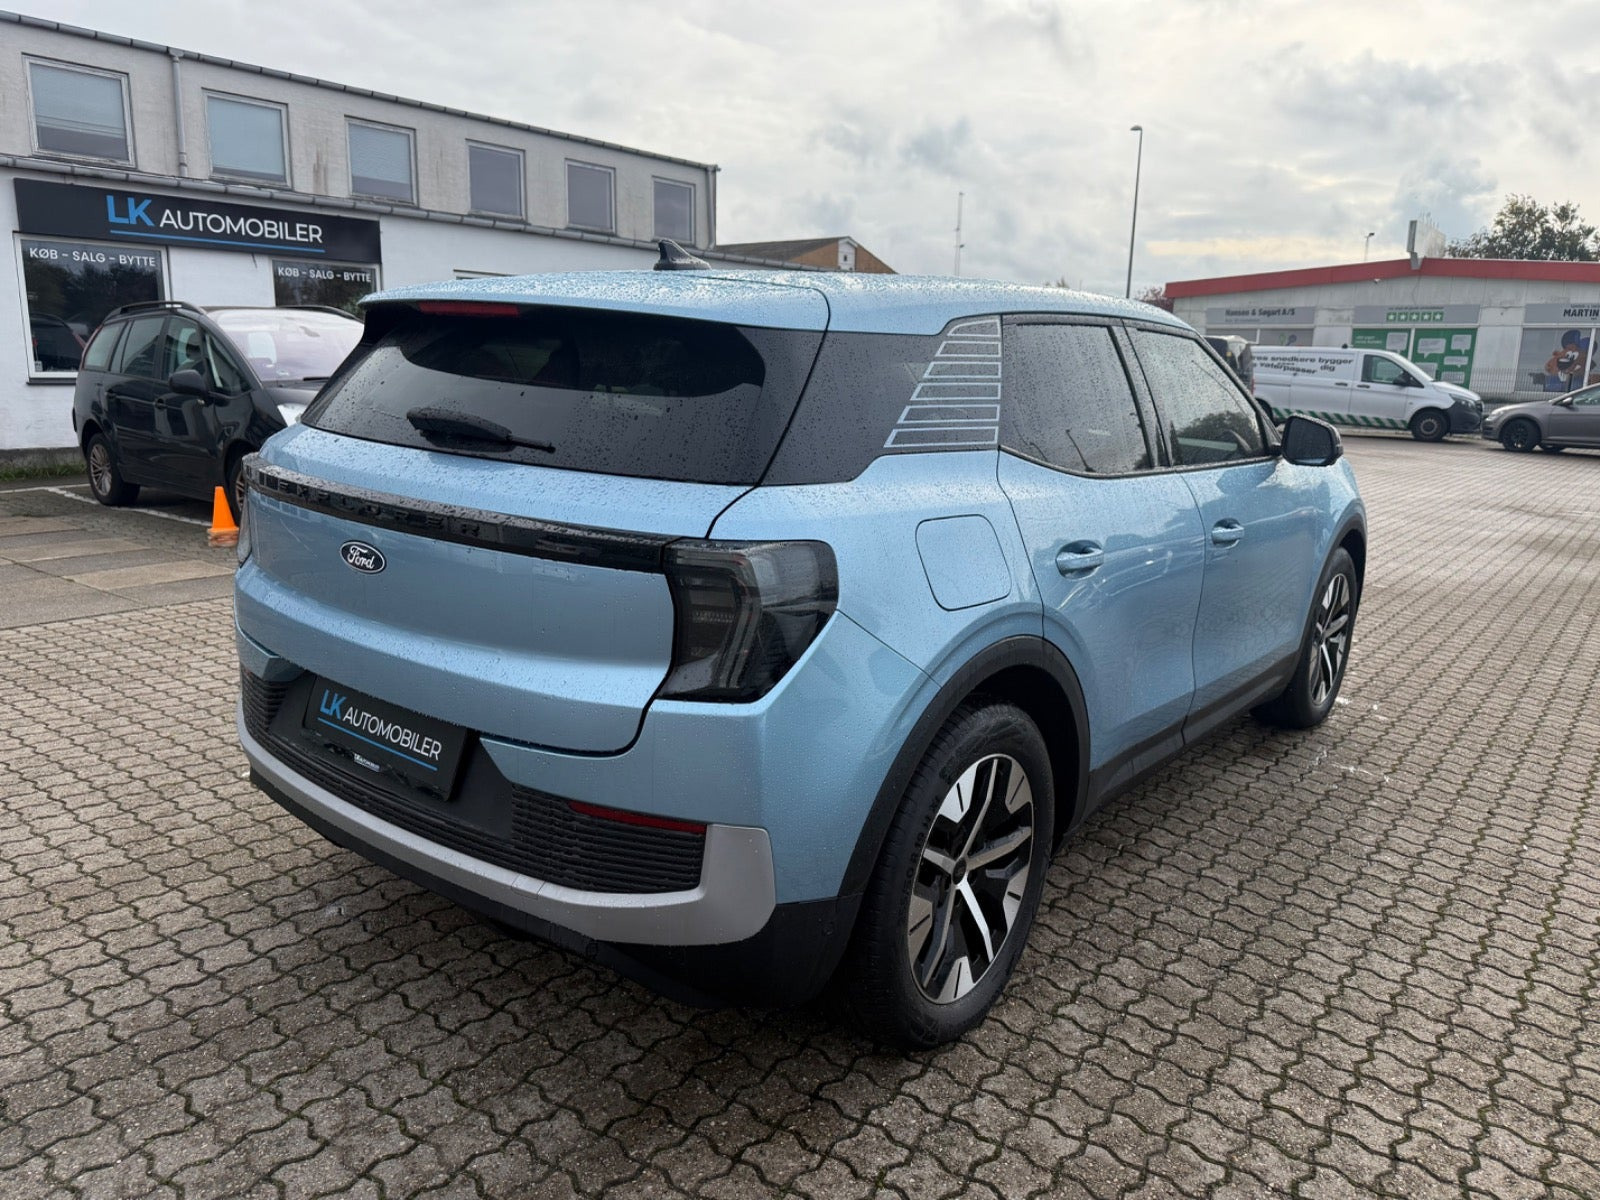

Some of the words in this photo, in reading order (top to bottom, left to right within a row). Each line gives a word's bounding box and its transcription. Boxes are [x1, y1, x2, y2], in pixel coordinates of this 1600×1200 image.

[106, 195, 155, 226] LK
[159, 208, 323, 243] AUTOMOBILER
[29, 247, 58, 259] KØB
[72, 251, 106, 263] SALG
[119, 255, 156, 267] BYTTE
[278, 267, 300, 277] KØB
[309, 269, 335, 280] SALG
[343, 272, 371, 282] BYTTE
[1282, 308, 1295, 316] A/S
[1563, 308, 1600, 317] MARTIN
[1318, 357, 1354, 365] bygger
[347, 545, 375, 569] Ford
[320, 689, 346, 720] LK
[342, 706, 442, 761] AUTOMOBILER
